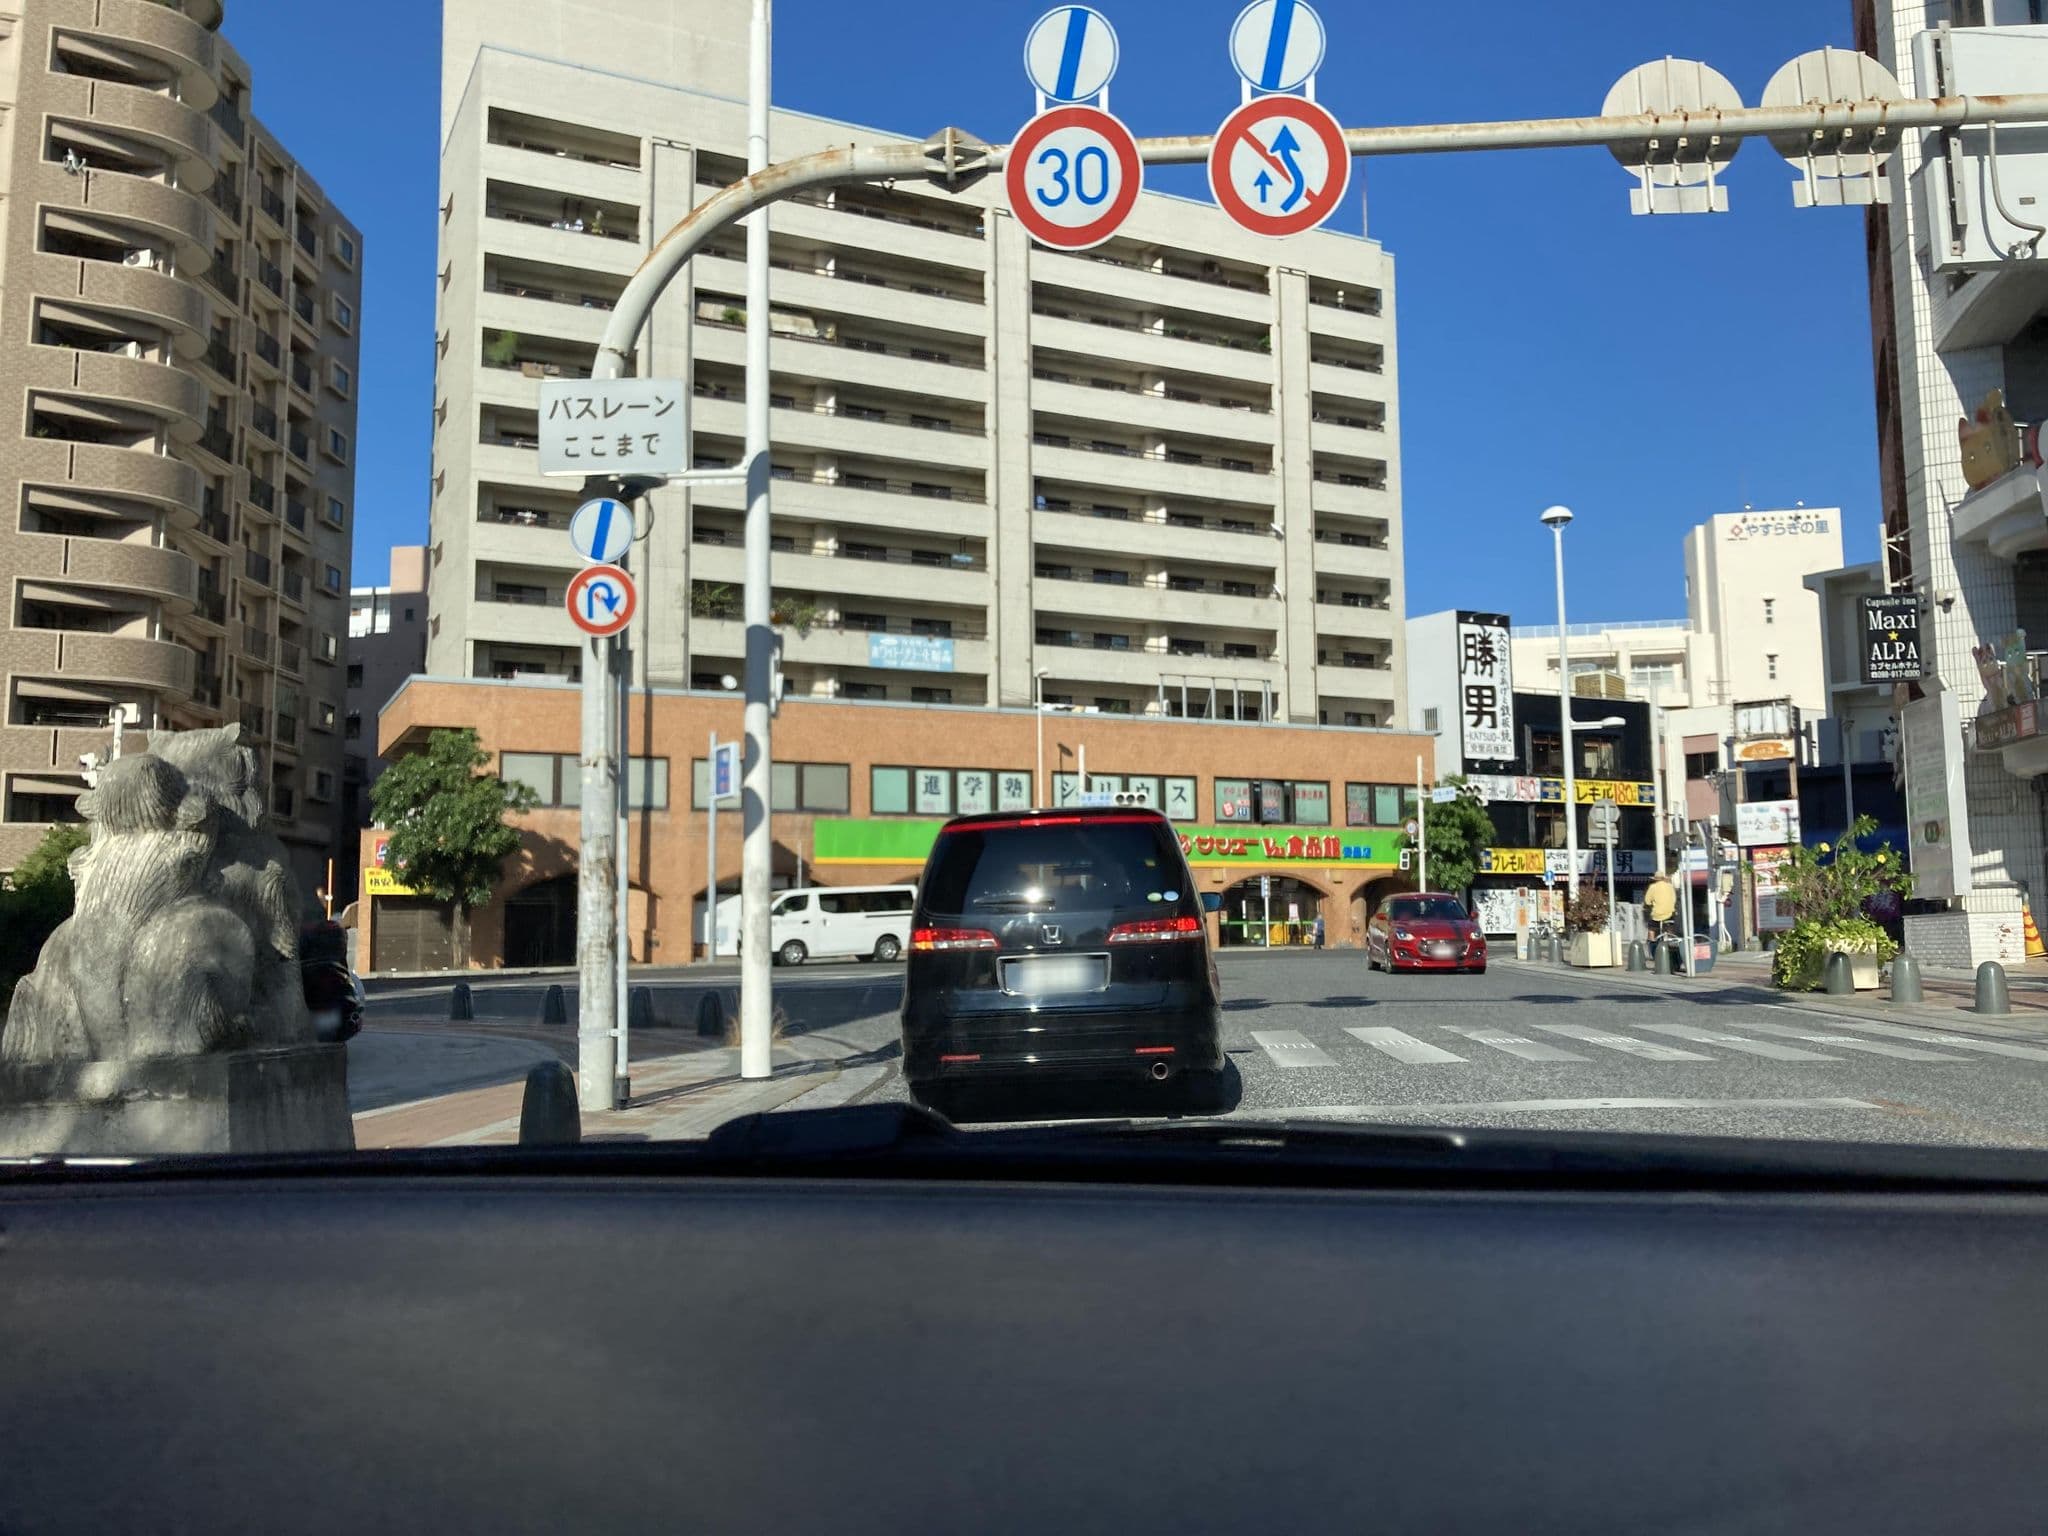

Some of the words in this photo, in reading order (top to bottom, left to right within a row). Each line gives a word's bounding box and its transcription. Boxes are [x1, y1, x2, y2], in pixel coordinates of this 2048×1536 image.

[1036, 147, 1109, 207] 30
[548, 395, 676, 421] バスレーン
[563, 432, 661, 459] ここまで
[1745, 520, 1830, 536] やすらぎの里
[1867, 608, 1917, 630] Maxi
[1871, 641, 1918, 660] ALPA
[1461, 631, 1498, 730] 勝男
[922, 775, 1024, 798] 進学塾
